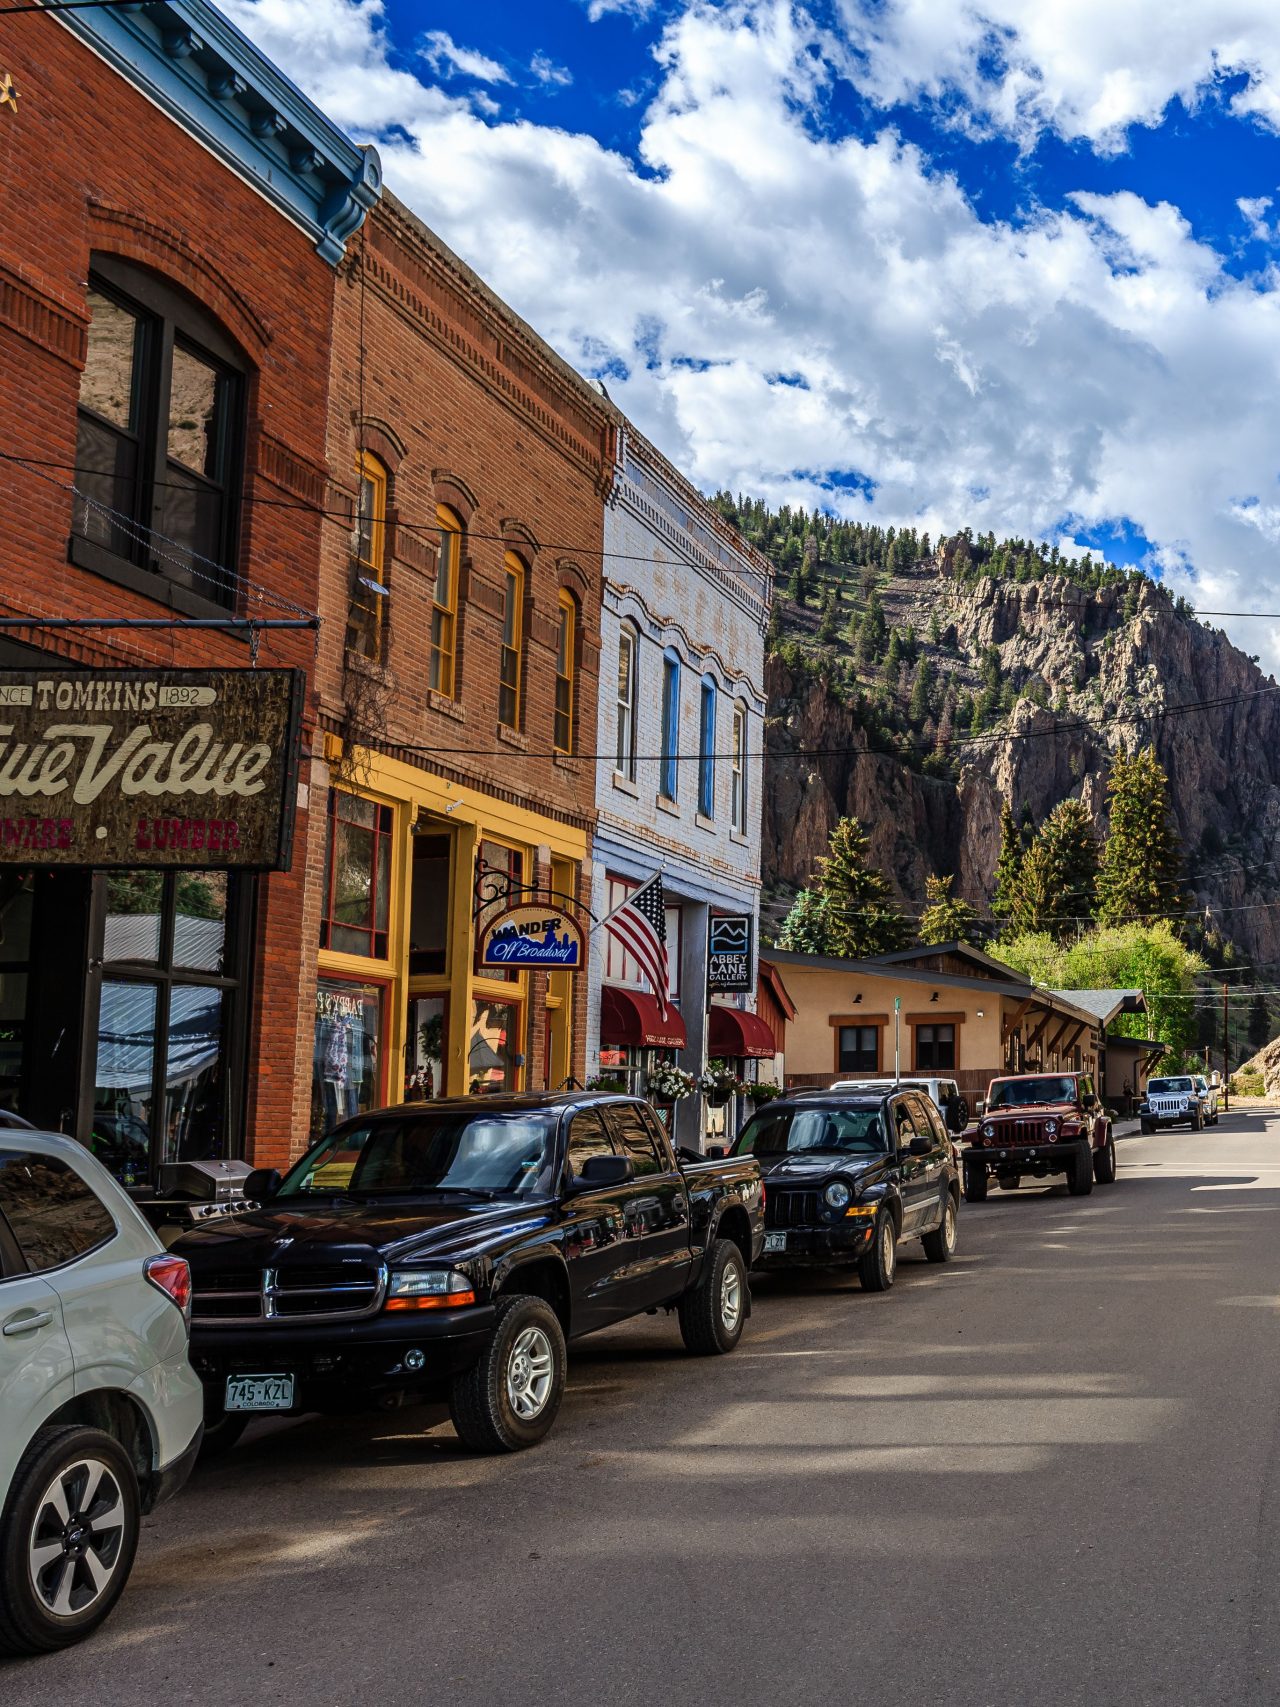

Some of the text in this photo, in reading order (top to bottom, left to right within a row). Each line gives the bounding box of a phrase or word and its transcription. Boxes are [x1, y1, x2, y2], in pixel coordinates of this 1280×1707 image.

[37, 680, 158, 712] TOMKINS
[165, 688, 200, 704] 1892
[42, 722, 272, 805] Value
[136, 818, 241, 850] LUMBER
[491, 917, 562, 940] WANDER
[493, 941, 572, 961] Off Broadway
[709, 954, 748, 964] ABBEY
[709, 963, 747, 975] LANE
[709, 973, 748, 981] GALLERY
